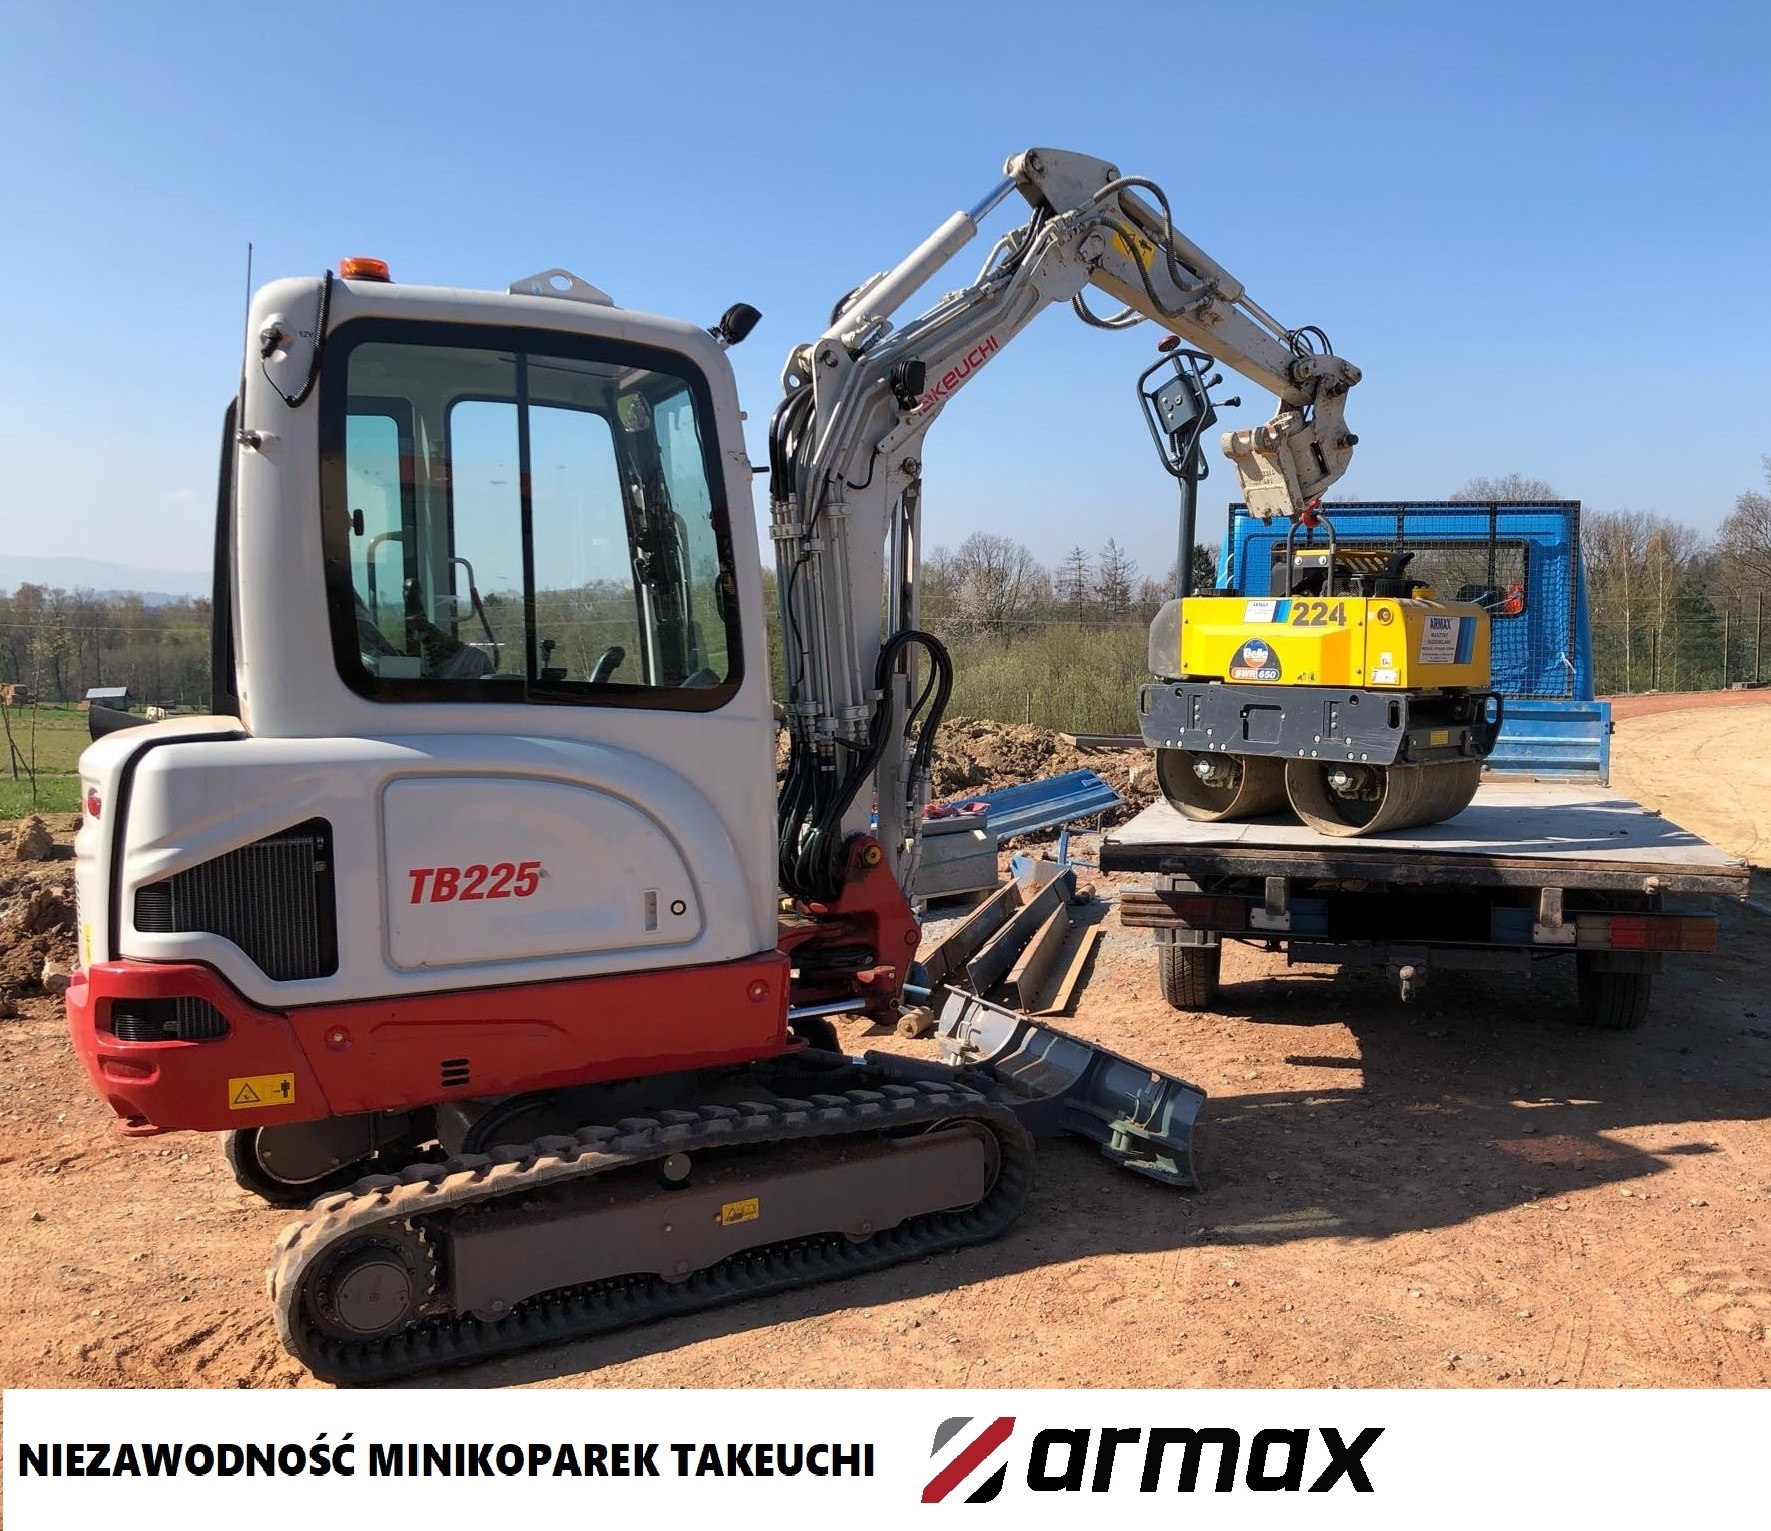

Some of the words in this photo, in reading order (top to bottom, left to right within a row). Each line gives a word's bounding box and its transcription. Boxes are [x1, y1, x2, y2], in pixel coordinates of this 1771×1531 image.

[1292, 602, 1346, 626] 224
[1244, 647, 1268, 659] Belle
[1258, 670, 1277, 679] 650
[409, 856, 541, 904] TB225
